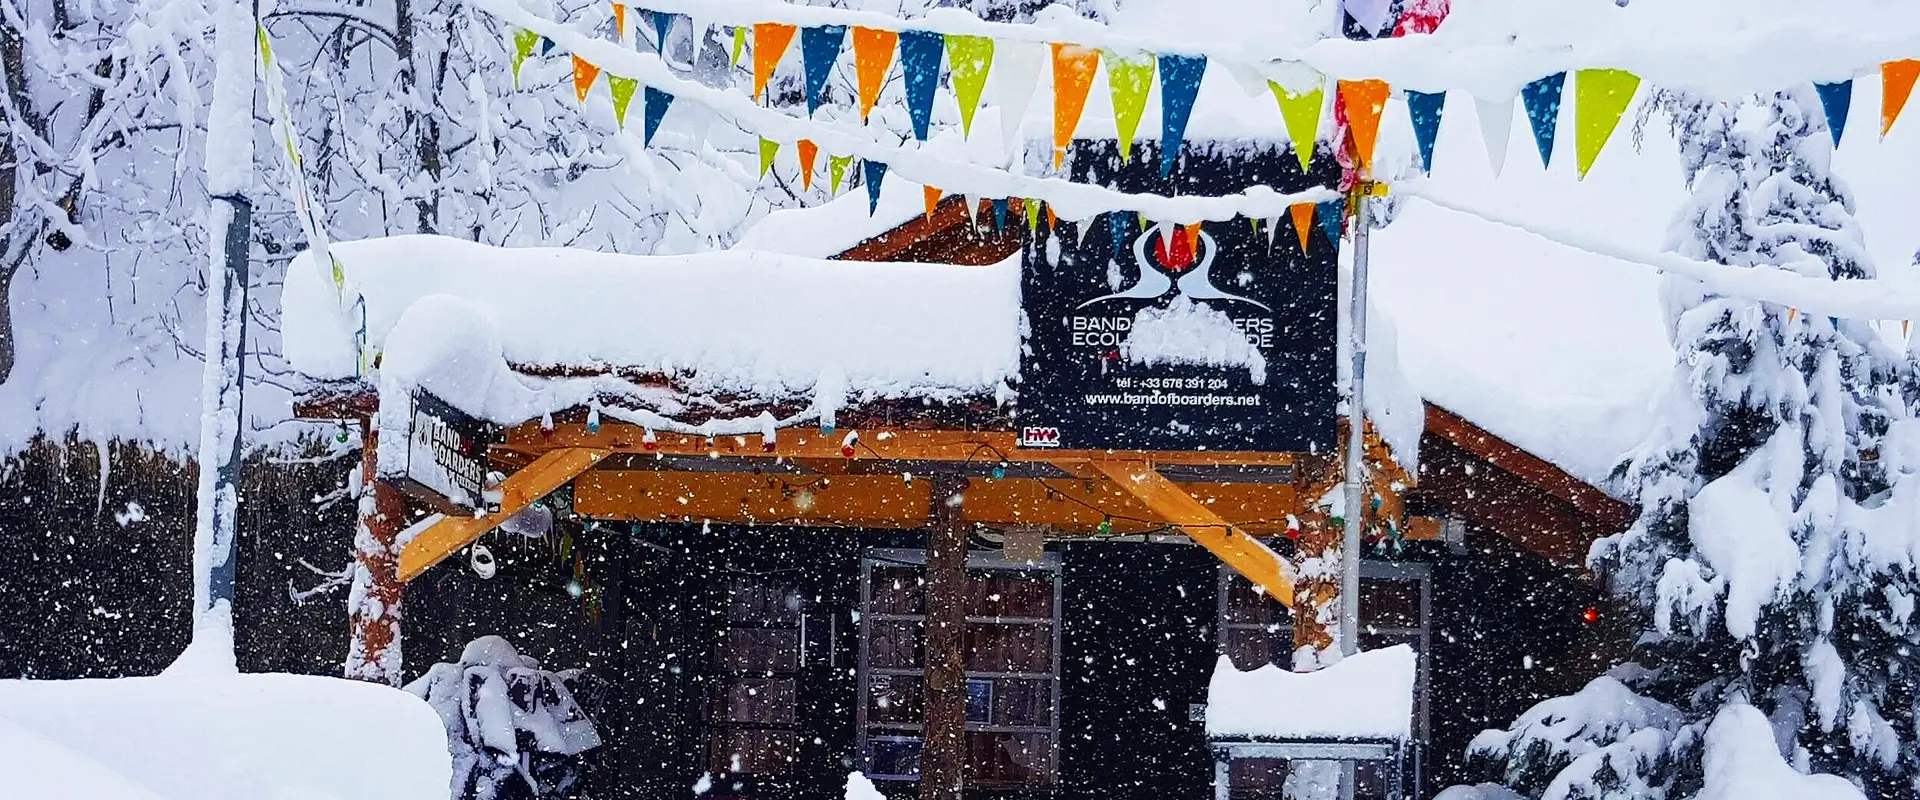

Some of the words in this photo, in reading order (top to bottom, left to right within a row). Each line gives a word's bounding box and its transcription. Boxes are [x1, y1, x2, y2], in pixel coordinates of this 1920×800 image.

[1072, 332, 1121, 346] ECOL
[1140, 378, 1160, 388] +33
[1185, 378, 1205, 389] 391
[1207, 378, 1228, 389] 204
[1085, 391, 1261, 406] www.bandofboarders.net
[432, 440, 482, 484] BOARDERS
